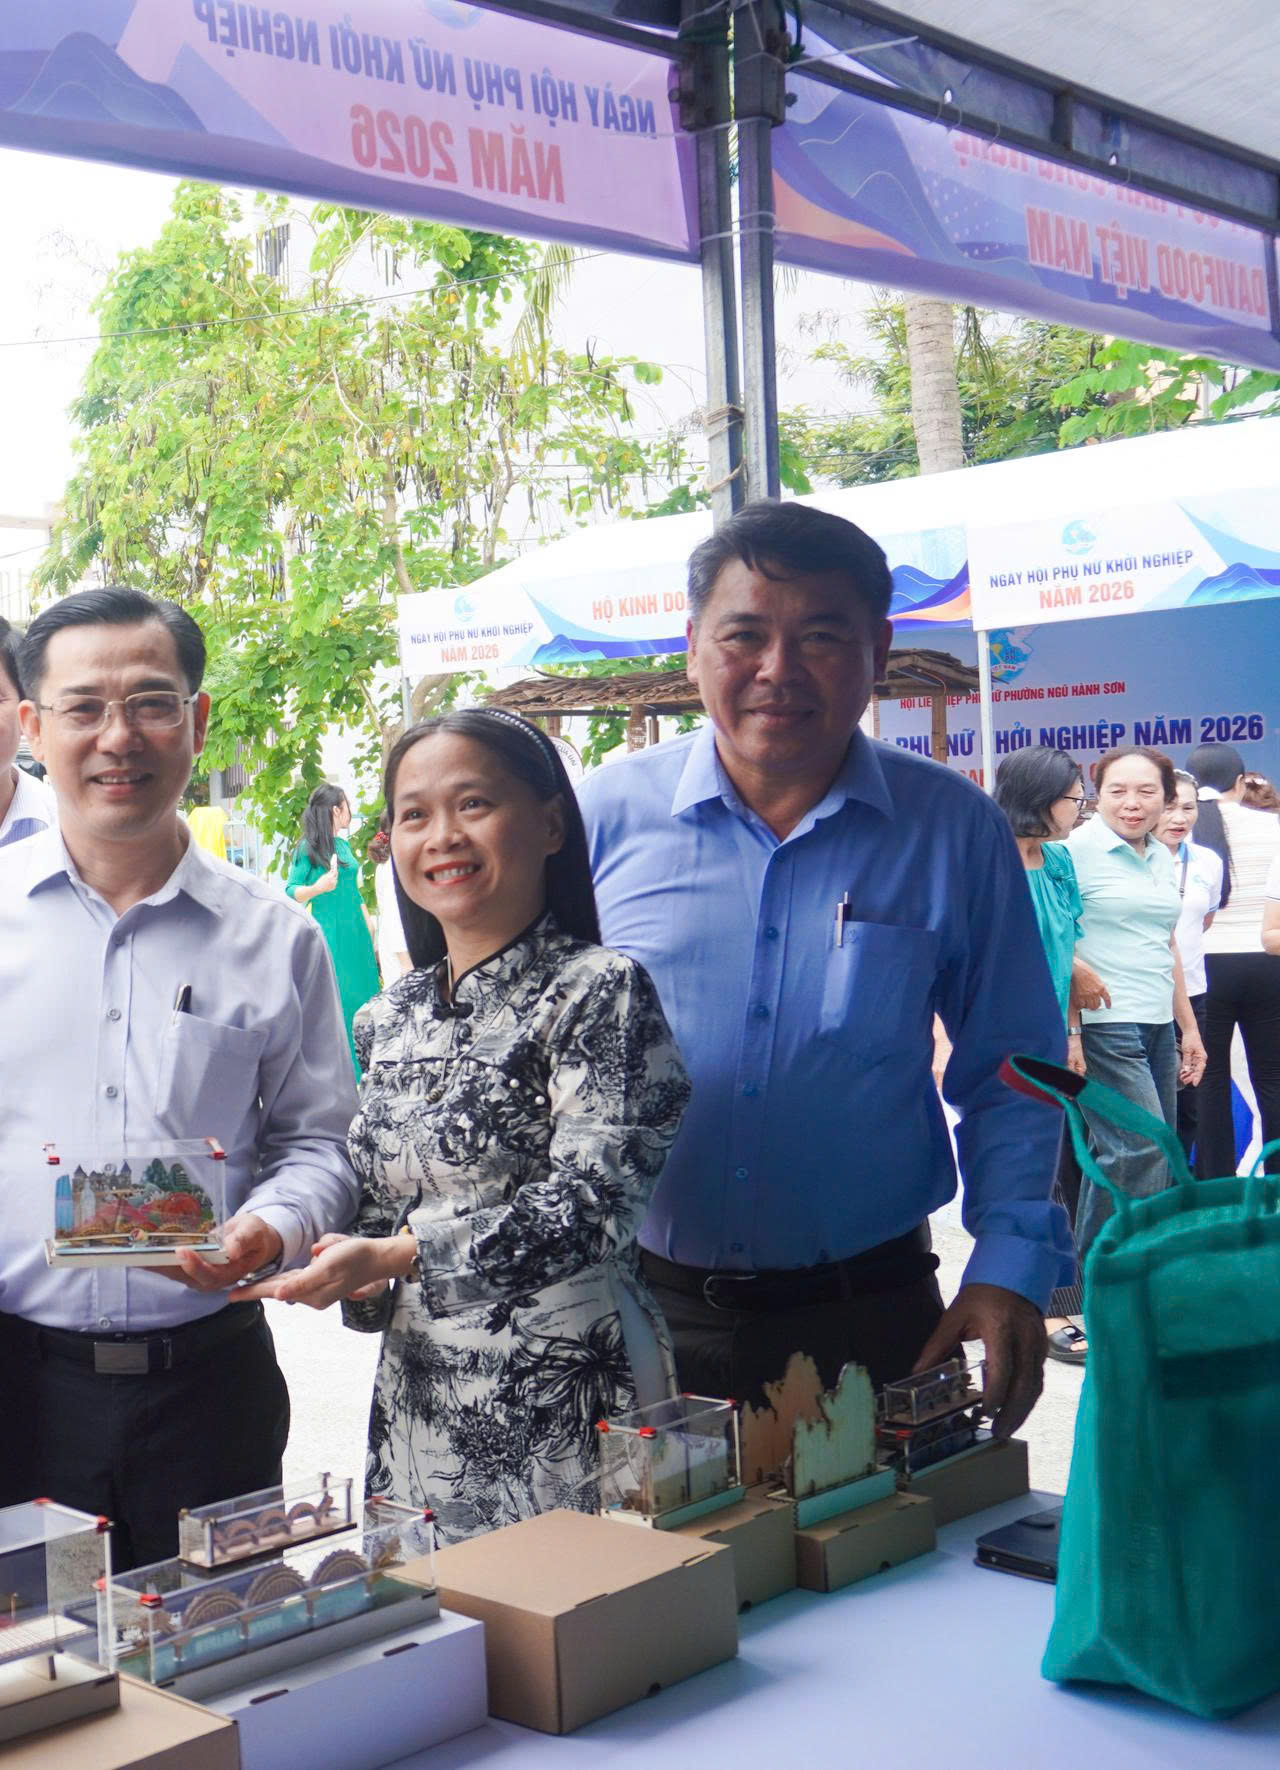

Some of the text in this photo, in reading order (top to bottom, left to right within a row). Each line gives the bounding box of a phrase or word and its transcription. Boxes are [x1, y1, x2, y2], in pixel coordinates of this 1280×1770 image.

[1088, 580, 1135, 604] 2026
[591, 591, 689, 623] HỘ KINH DO
[471, 643, 500, 661] 2026
[1003, 686, 1045, 701] PHƯỜNG
[1071, 683, 1100, 696] HÀNH
[1103, 681, 1125, 694] SƠN
[946, 727, 975, 757] NỮ
[1039, 718, 1126, 754] NGHIỆP
[1133, 714, 1192, 746] NĂM
[1200, 714, 1264, 743] 2026
